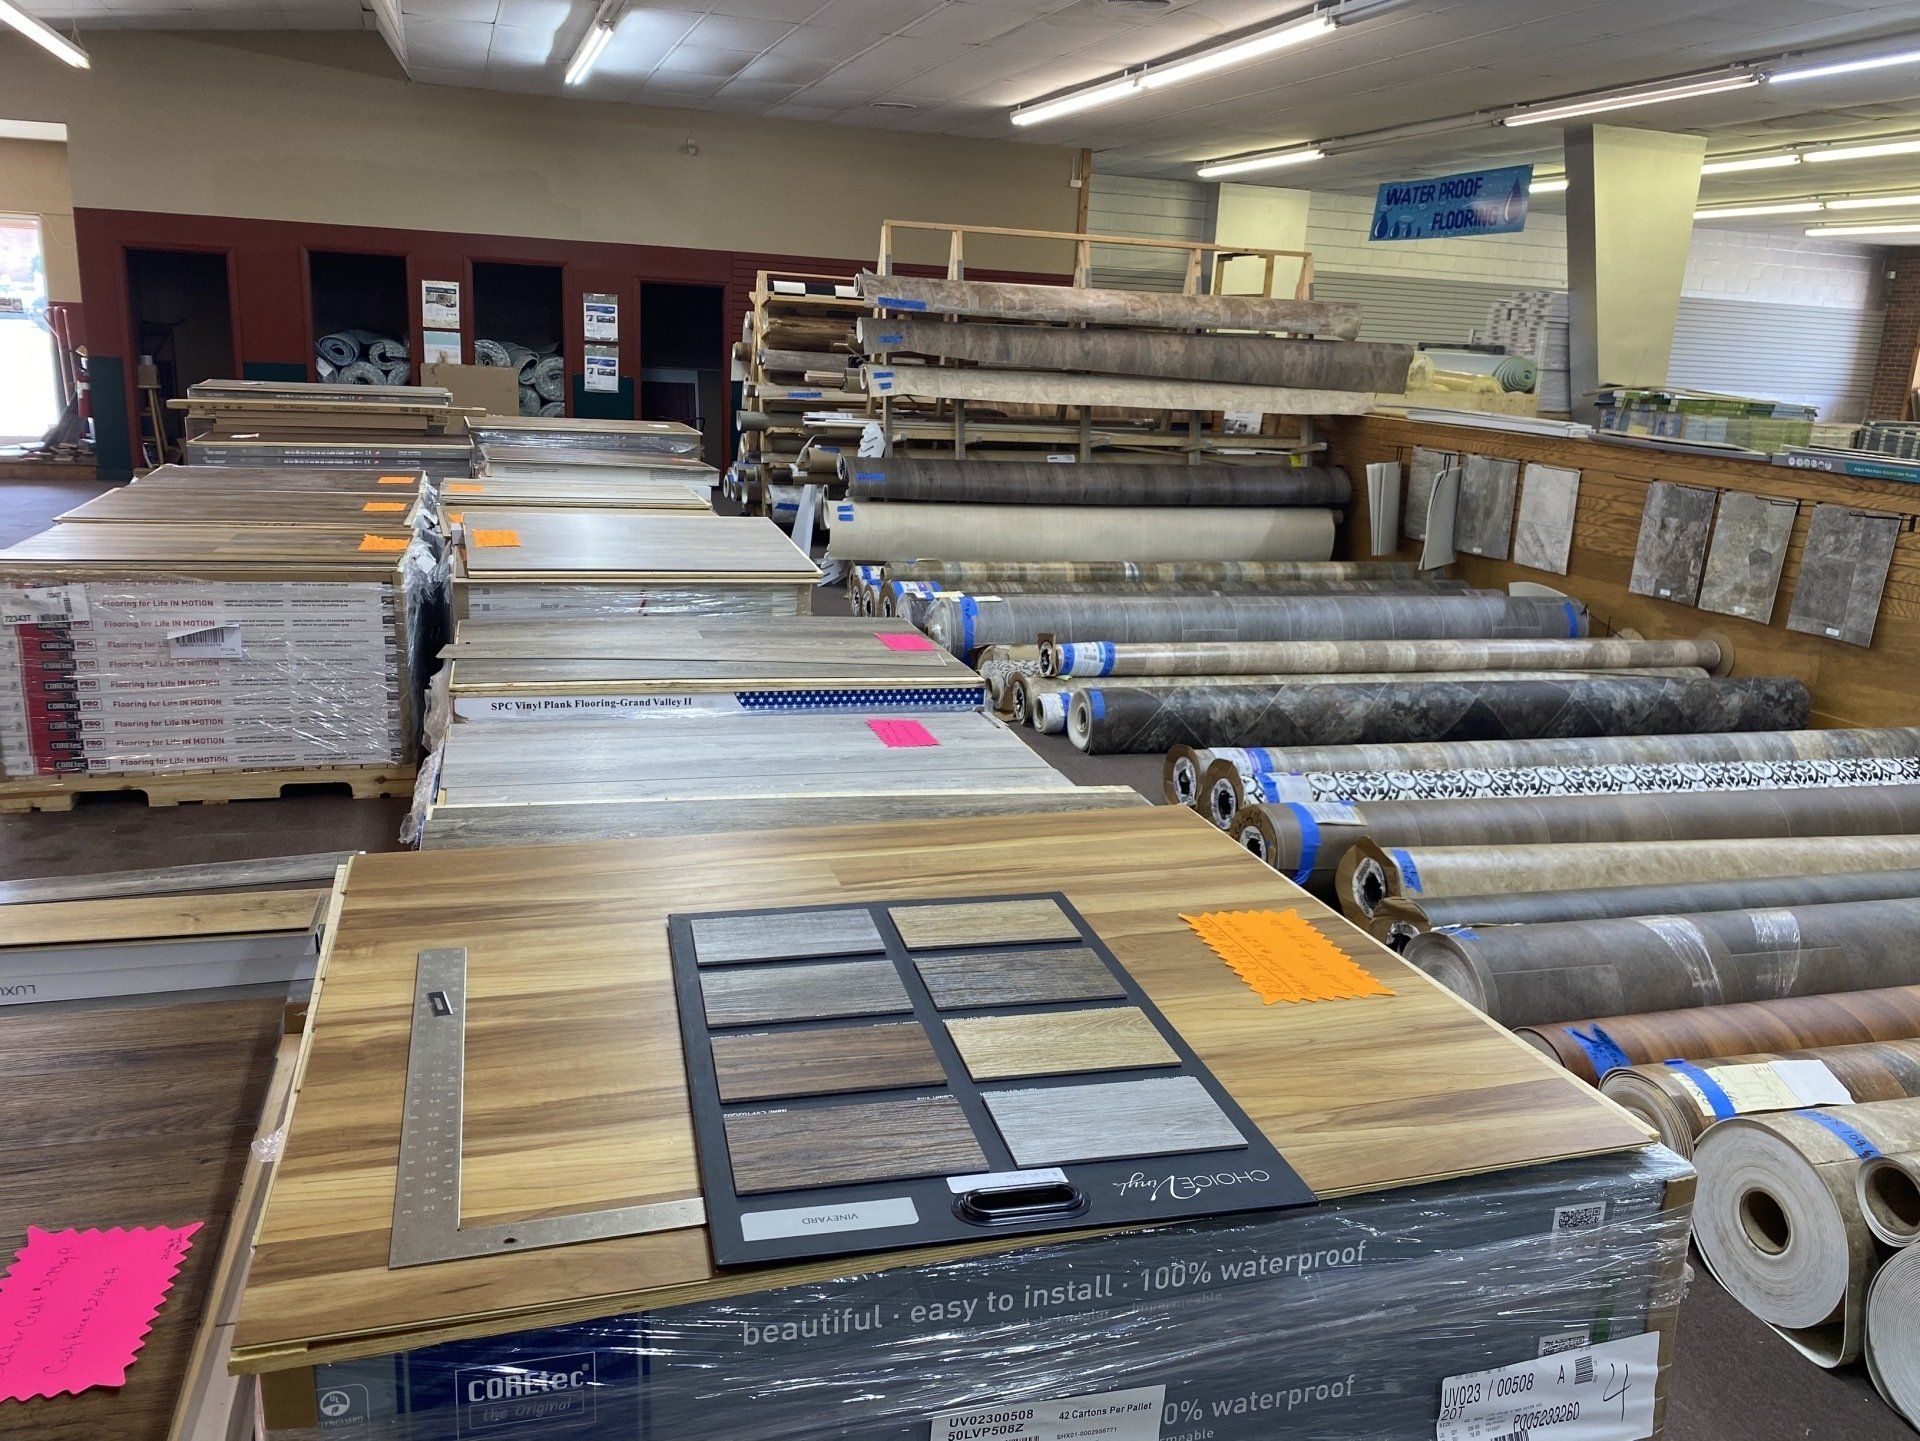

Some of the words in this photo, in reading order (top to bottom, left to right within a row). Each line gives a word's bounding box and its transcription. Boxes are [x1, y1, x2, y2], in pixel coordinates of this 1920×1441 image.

[1386, 184, 1435, 206] WATER
[1438, 177, 1484, 200] PROOF
[1431, 206, 1498, 231] FLOORING
[491, 702, 513, 711] SPC
[515, 701, 542, 712] Vinyl
[544, 700, 572, 709] Plank
[574, 698, 651, 710] Flooring-Grand
[653, 698, 681, 708] Valley
[684, 697, 692, 706] II
[192, 718, 224, 726] MOTION
[193, 737, 225, 745] MOTION
[1112, 1172, 1201, 1201] Vinyl
[1177, 1170, 1269, 1190] CHOICE
[802, 1213, 859, 1224] VINEYARD
[743, 1310, 882, 1346] beautiful
[910, 1296, 979, 1326] easy
[987, 1290, 1014, 1313] to
[1024, 1274, 1113, 1308] install
[1140, 1263, 1212, 1292] 100%
[1220, 1239, 1368, 1281] waterproof
[1164, 1399, 1203, 1425] 0%
[1211, 1373, 1355, 1418] waterproof
[1444, 1383, 1481, 1409] UV023
[1497, 1373, 1534, 1398] 00508
[1557, 1364, 1565, 1385] A
[1603, 1363, 1632, 1422] 4
[483, 1407, 508, 1422] the
[515, 1395, 572, 1418] Original
[949, 1409, 1034, 1428] UV02300508
[1058, 1410, 1070, 1421] 42
[1071, 1406, 1107, 1420] Cartons
[1109, 1404, 1126, 1415] Per
[1126, 1401, 1153, 1413] Pallet
[1513, 1401, 1580, 1435] P005233260
[947, 1423, 1025, 1441] 50LVP508Z
